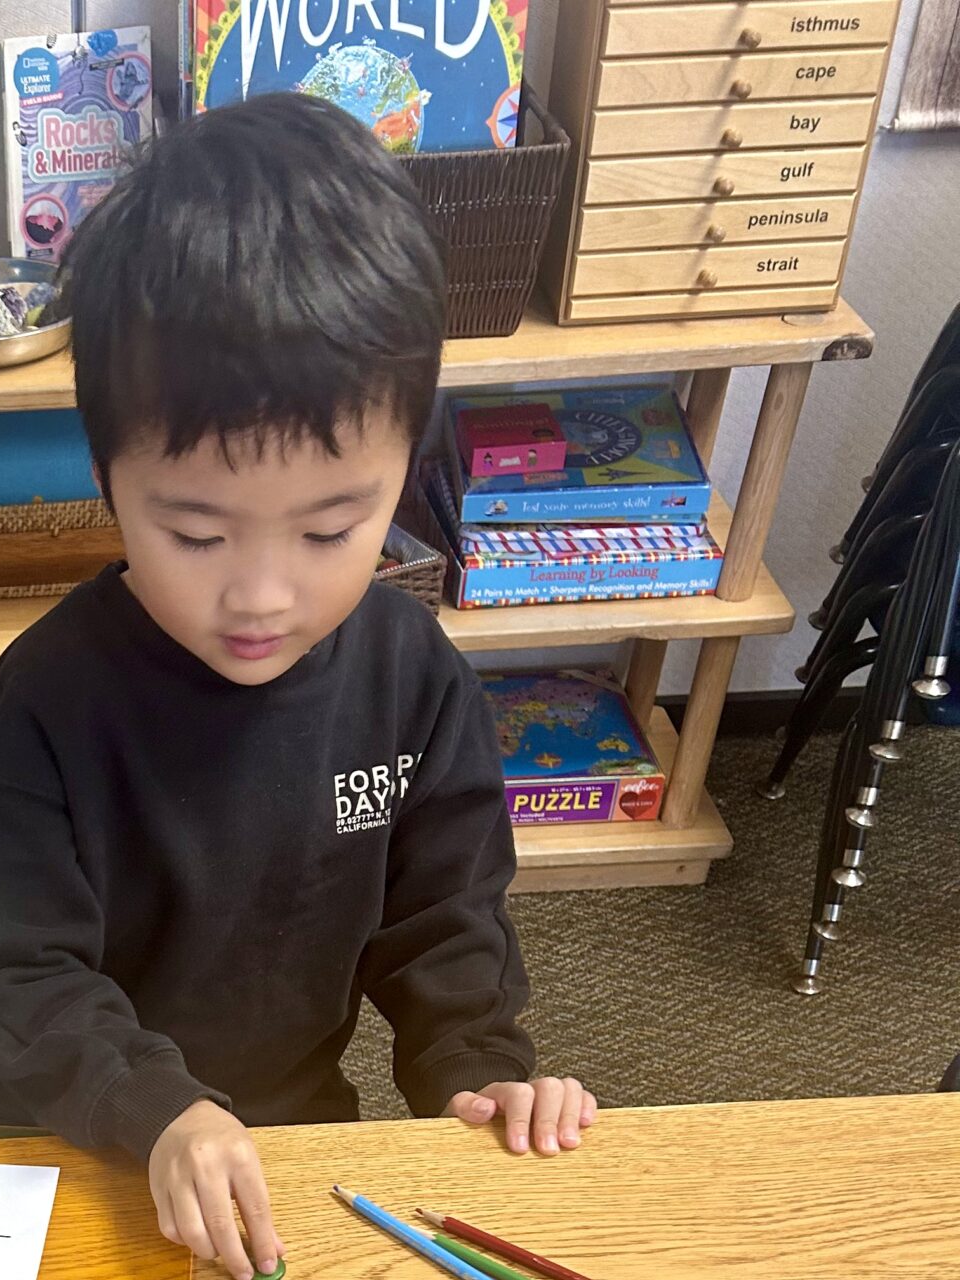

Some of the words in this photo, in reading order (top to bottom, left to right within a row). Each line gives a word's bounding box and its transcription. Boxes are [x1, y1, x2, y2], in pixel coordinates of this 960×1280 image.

[790, 16, 860, 32] isthmus
[20, 75, 50, 84] ULTIMATE
[795, 64, 837, 80] cape
[24, 84, 51, 95] Explorer
[45, 114, 117, 148] Rocks
[790, 115, 821, 133] bay
[35, 151, 48, 175] &
[780, 162, 814, 182] gulf
[748, 209, 828, 229] peninsula
[756, 256, 799, 272] strait
[522, 501, 539, 512] Test
[544, 503, 569, 513] your
[574, 501, 617, 511] memory
[623, 496, 651, 508] skills!
[530, 568, 585, 582] Learning
[590, 567, 605, 581] by
[608, 566, 658, 579] Looking
[471, 589, 482, 597] 24
[484, 588, 503, 597] Pairs
[516, 586, 539, 595] Match
[550, 584, 586, 595] Sharpens
[589, 582, 632, 594] Recognition
[637, 581, 653, 590] and
[656, 580, 687, 591] Memory
[690, 578, 713, 588] Skills!
[334, 764, 390, 797] FOR
[397, 753, 422, 776] P
[514, 791, 603, 812] PUZZLE
